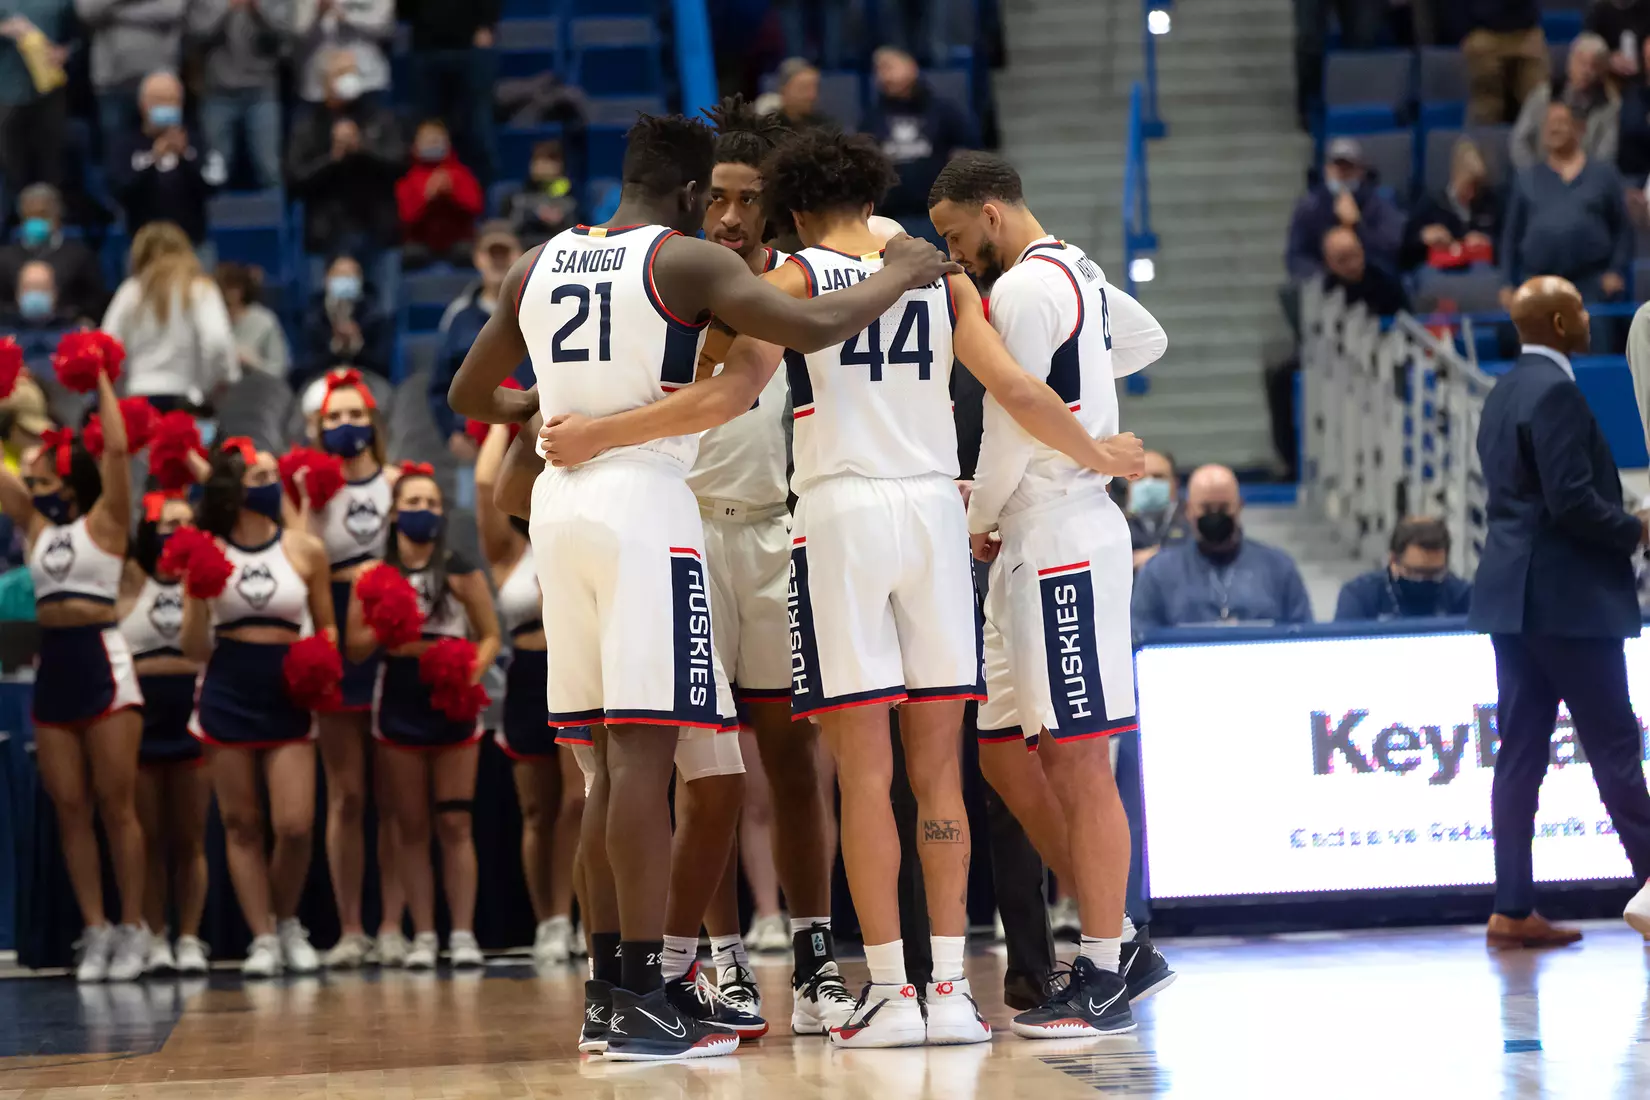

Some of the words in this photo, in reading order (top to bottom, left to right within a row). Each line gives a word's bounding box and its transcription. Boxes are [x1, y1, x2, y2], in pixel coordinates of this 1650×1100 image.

[552, 247, 627, 274] SANOGO
[551, 282, 613, 363] 21
[840, 301, 934, 381] 44
[688, 570, 709, 707] HUSKIES
[1054, 584, 1092, 719] HUSKIES
[925, 829, 960, 841] NEXT?
[646, 952, 663, 966] 23
